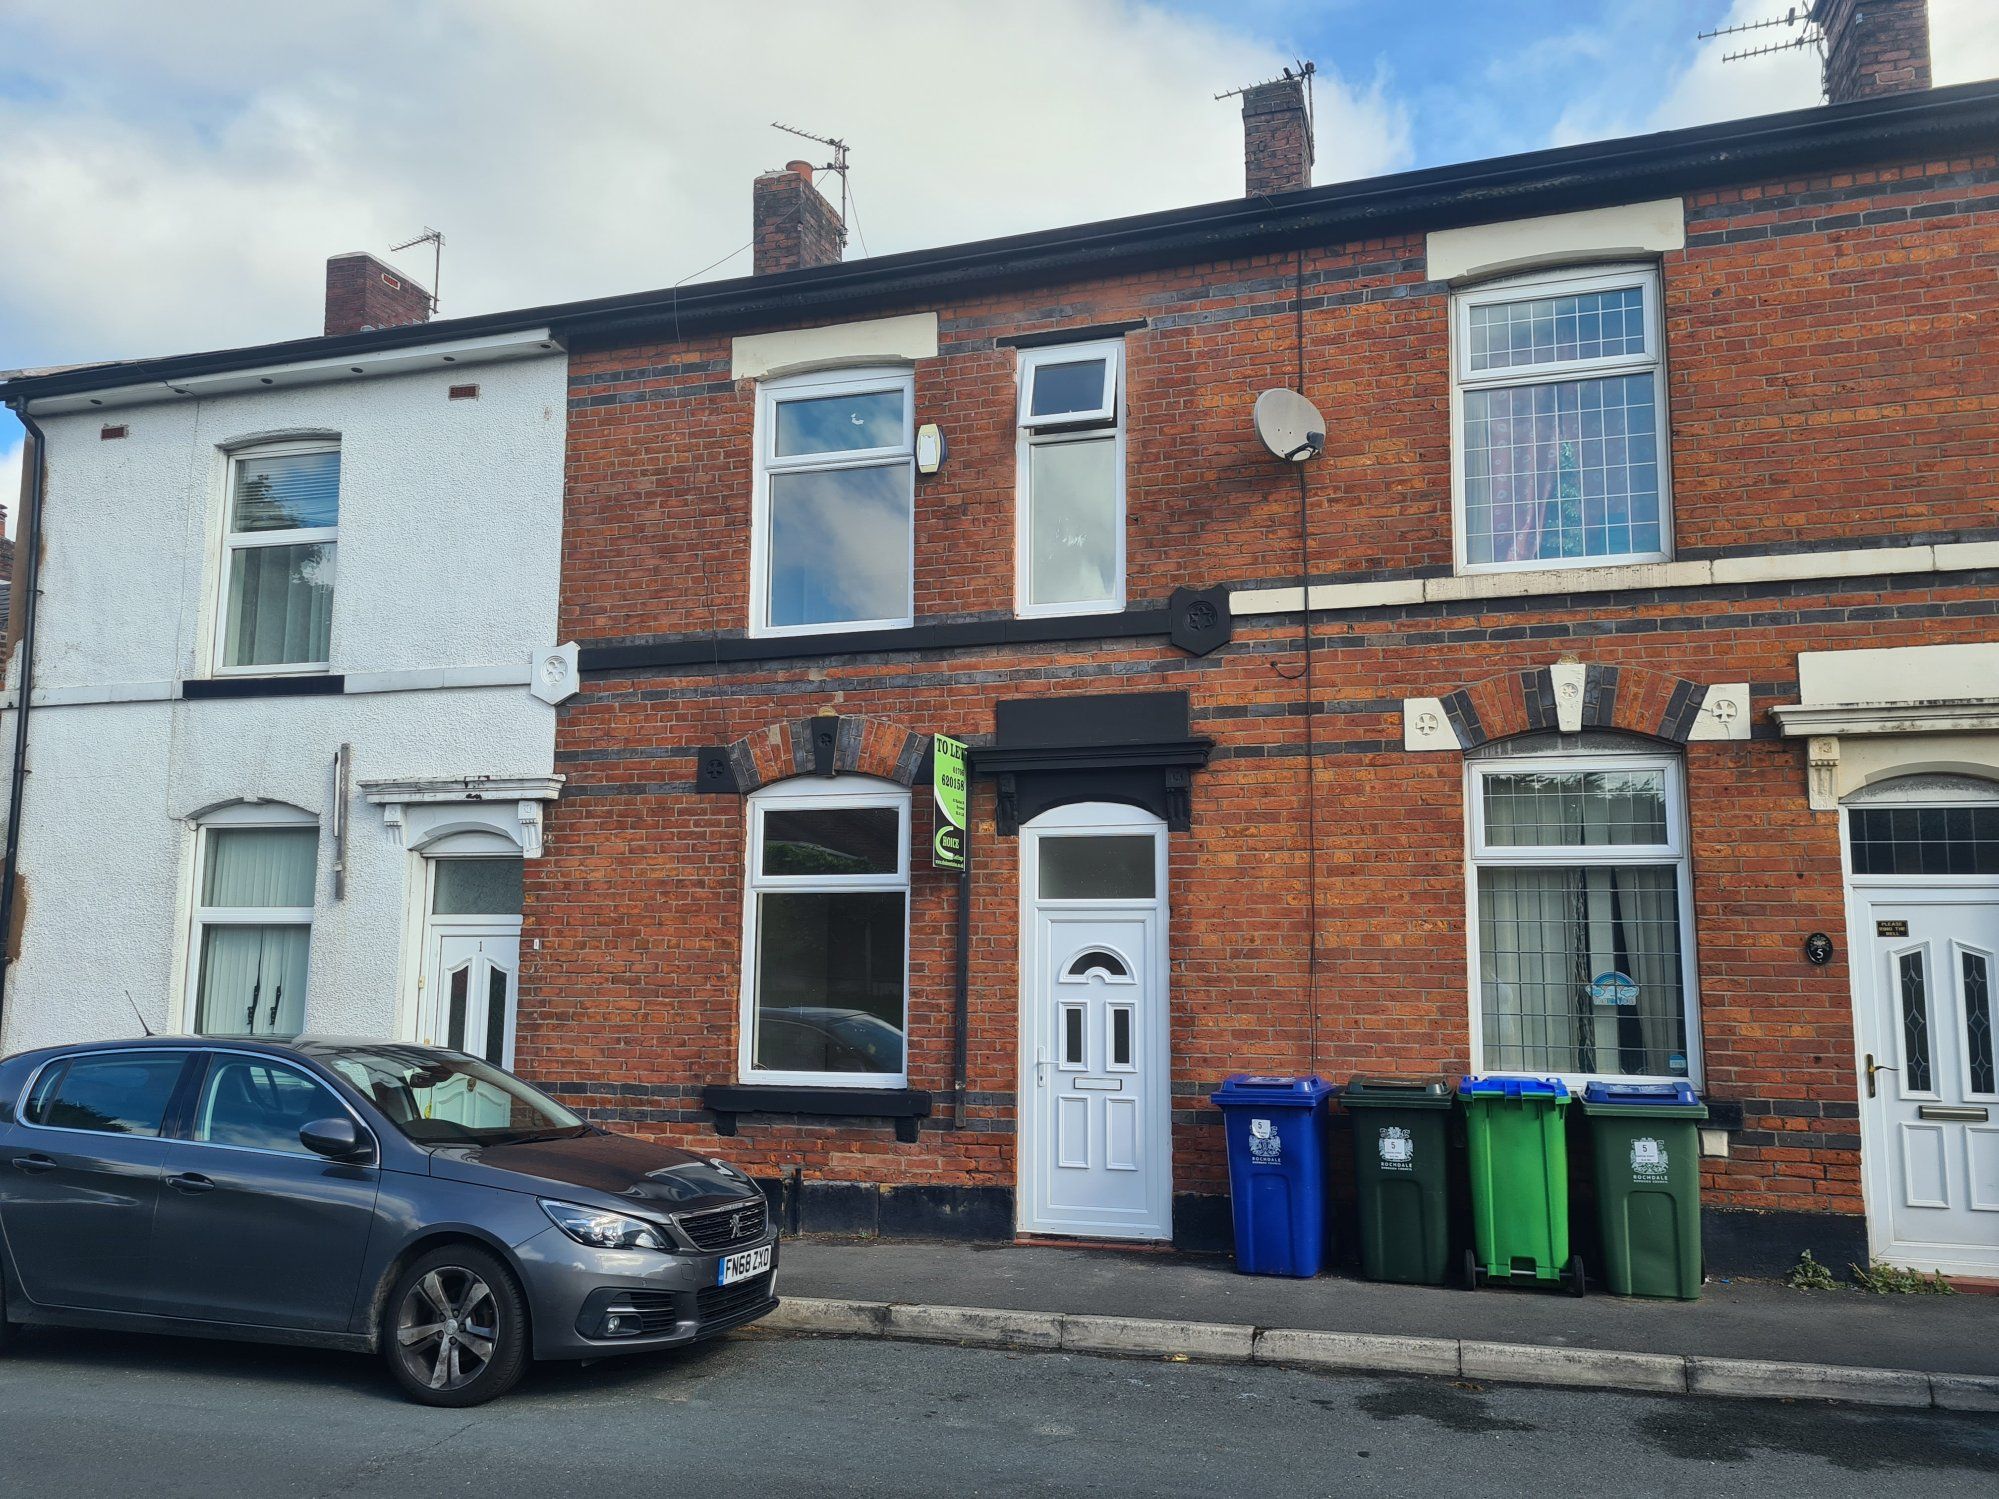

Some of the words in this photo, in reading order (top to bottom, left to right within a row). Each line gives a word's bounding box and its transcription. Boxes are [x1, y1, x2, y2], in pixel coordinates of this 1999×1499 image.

[937, 738, 948, 755] TO
[950, 743, 967, 761] LET
[942, 774, 964, 791] 620158
[1816, 948, 1823, 958] 5
[1258, 1122, 1262, 1130] 5
[1391, 1142, 1396, 1150] 5
[1642, 1144, 1648, 1152] 5
[726, 1253, 751, 1279] FN68
[753, 1248, 769, 1270] ZXO
